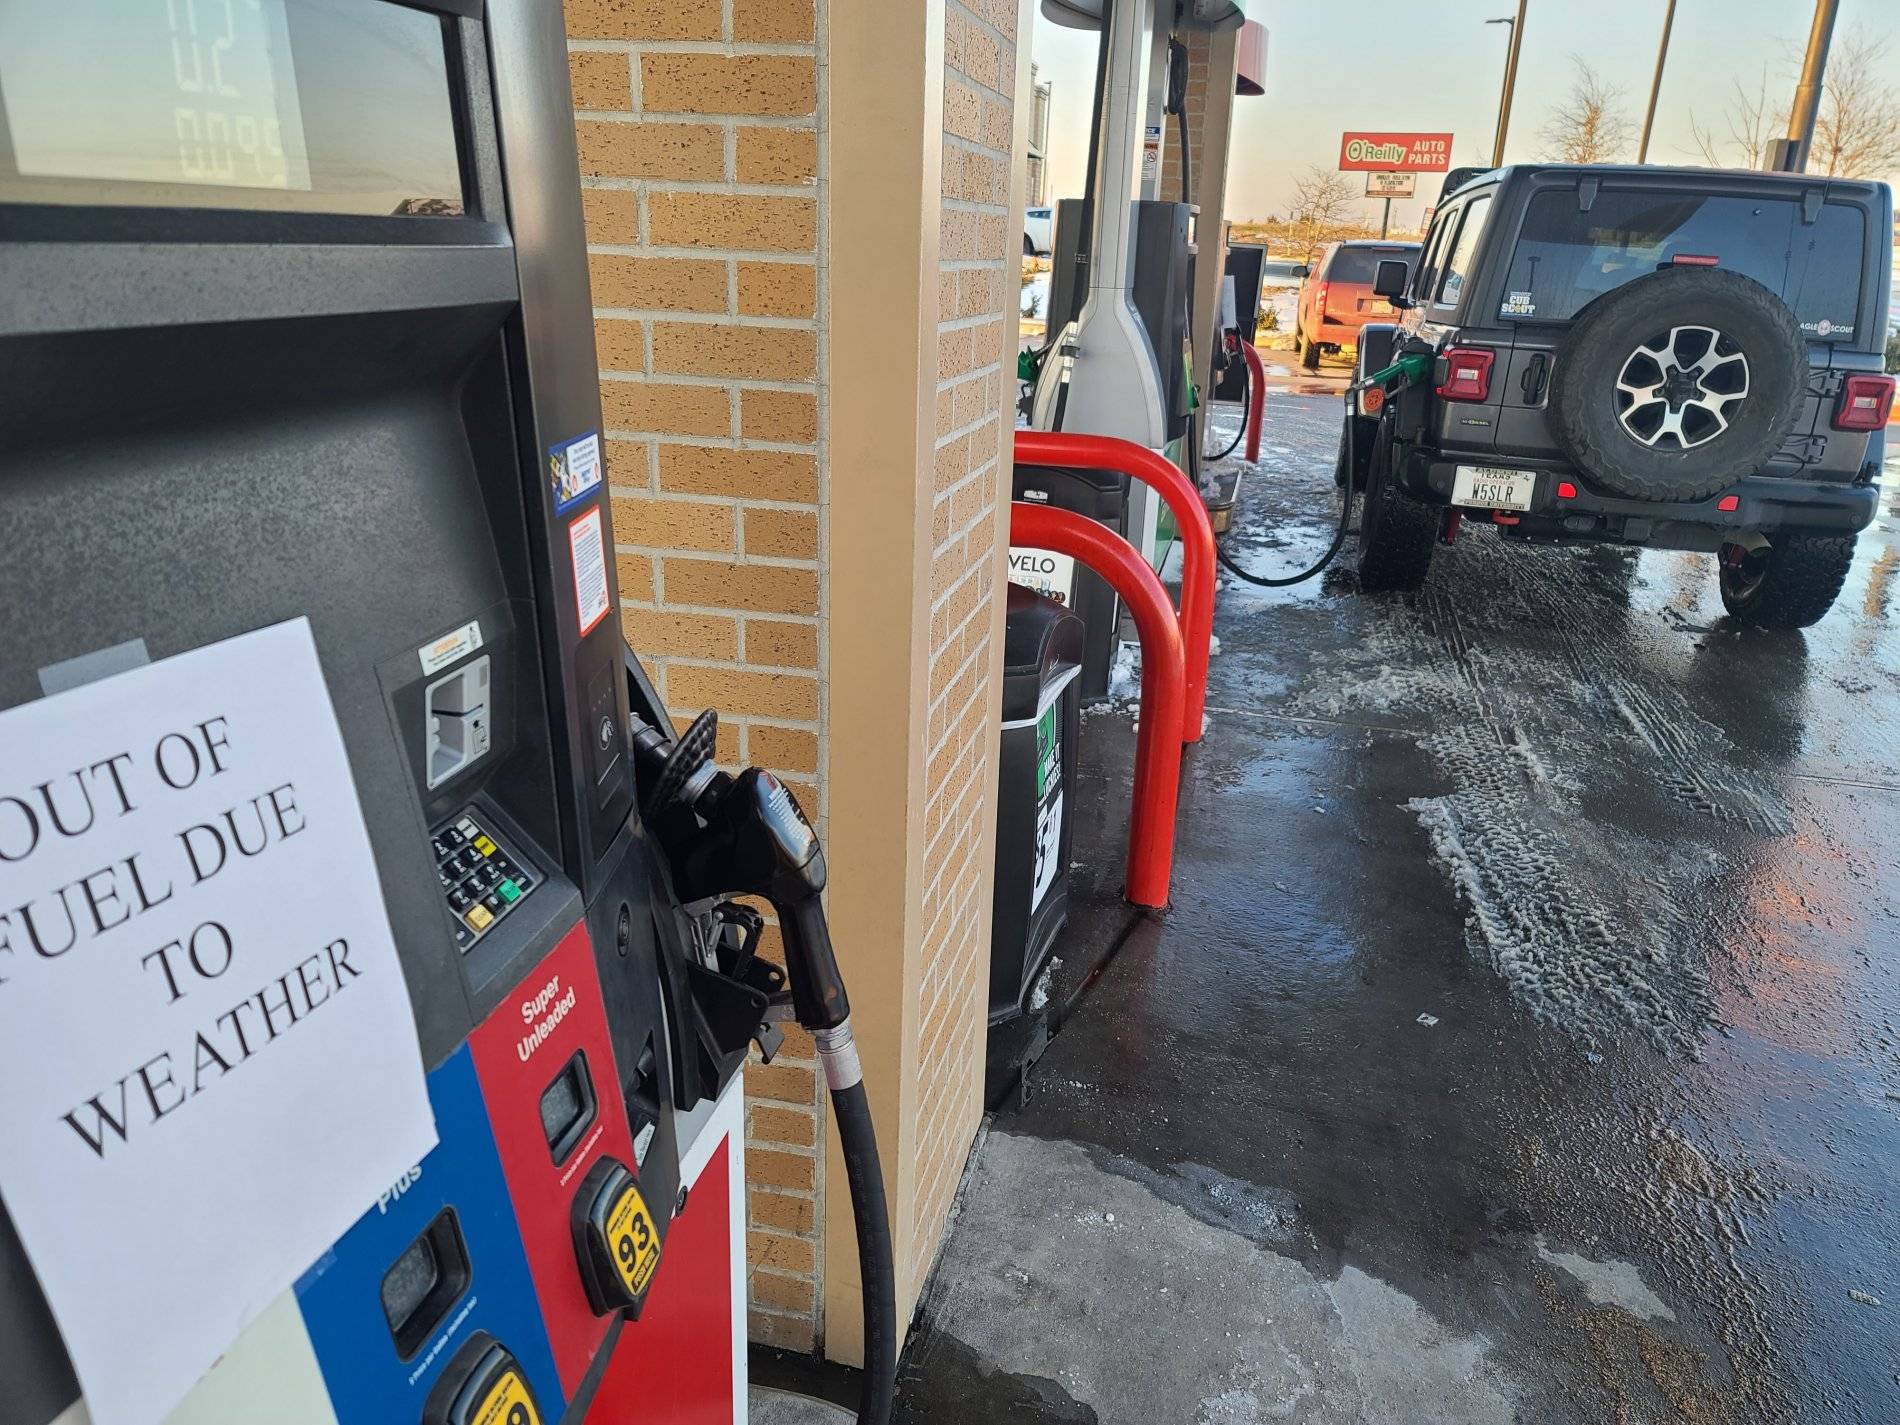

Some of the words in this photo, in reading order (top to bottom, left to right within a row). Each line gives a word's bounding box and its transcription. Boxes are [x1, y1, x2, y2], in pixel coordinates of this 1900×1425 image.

[1348, 141, 1404, 162] O'Reilly
[1413, 140, 1445, 152] AUTO
[1408, 153, 1447, 165] PARTS
[1501, 303, 1535, 313] SCOUT
[1510, 296, 1531, 304] CUB
[1800, 322, 1818, 331] AGLE
[1830, 324, 1854, 333] SCOUT
[1472, 483, 1514, 503] W5SLR
[1009, 555, 1055, 574] VELO
[0, 752, 138, 862] OUT
[154, 716, 232, 790] OF
[175, 782, 307, 887] DUE
[142, 920, 233, 1005] TO
[521, 975, 560, 1025] Super
[516, 986, 576, 1062] Unleaded
[58, 937, 363, 1160] WEATHER
[618, 1211, 650, 1274] 93
